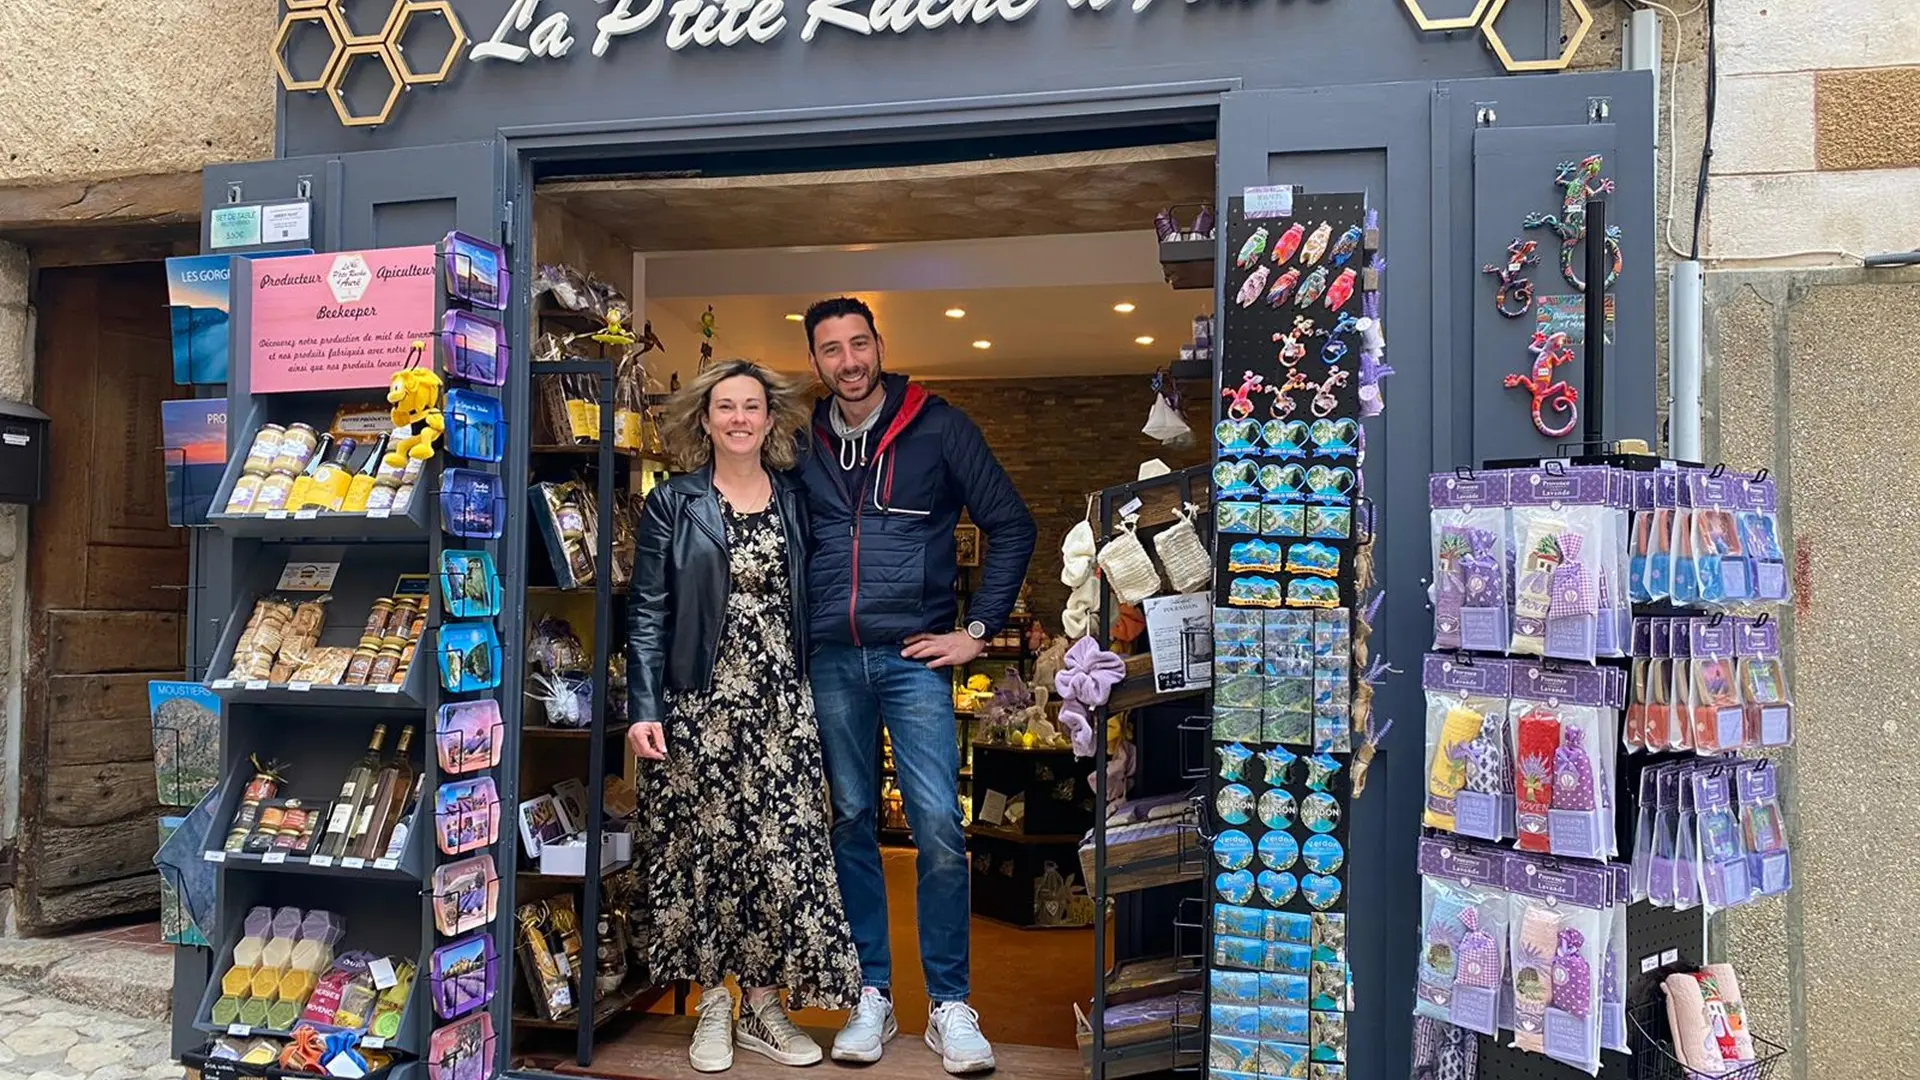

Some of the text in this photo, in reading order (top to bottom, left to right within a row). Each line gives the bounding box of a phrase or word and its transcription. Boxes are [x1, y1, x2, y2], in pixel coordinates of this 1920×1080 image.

[181, 268, 231, 283] LES GORG
[260, 264, 436, 290] Producteur Apiculteur
[316, 304, 378, 321] Beekeeper
[258, 338, 296, 349] Découvrez
[298, 336, 318, 346] notre
[320, 333, 360, 346] production
[363, 332, 373, 342] de
[375, 331, 393, 341] miel
[394, 330, 404, 340] de
[268, 352, 276, 361] et
[293, 349, 326, 361] produits
[327, 347, 365, 360] fabriqués
[386, 344, 407, 354] notre
[287, 362, 307, 373] ainsi
[309, 364, 324, 373] que
[326, 363, 340, 371] nos
[341, 359, 375, 372] produits
[157, 684, 213, 697] MOUSTIERS
[1219, 800, 1255, 810] VERDON
[1259, 805, 1296, 815] VERDON
[1303, 807, 1340, 818] VERDON
